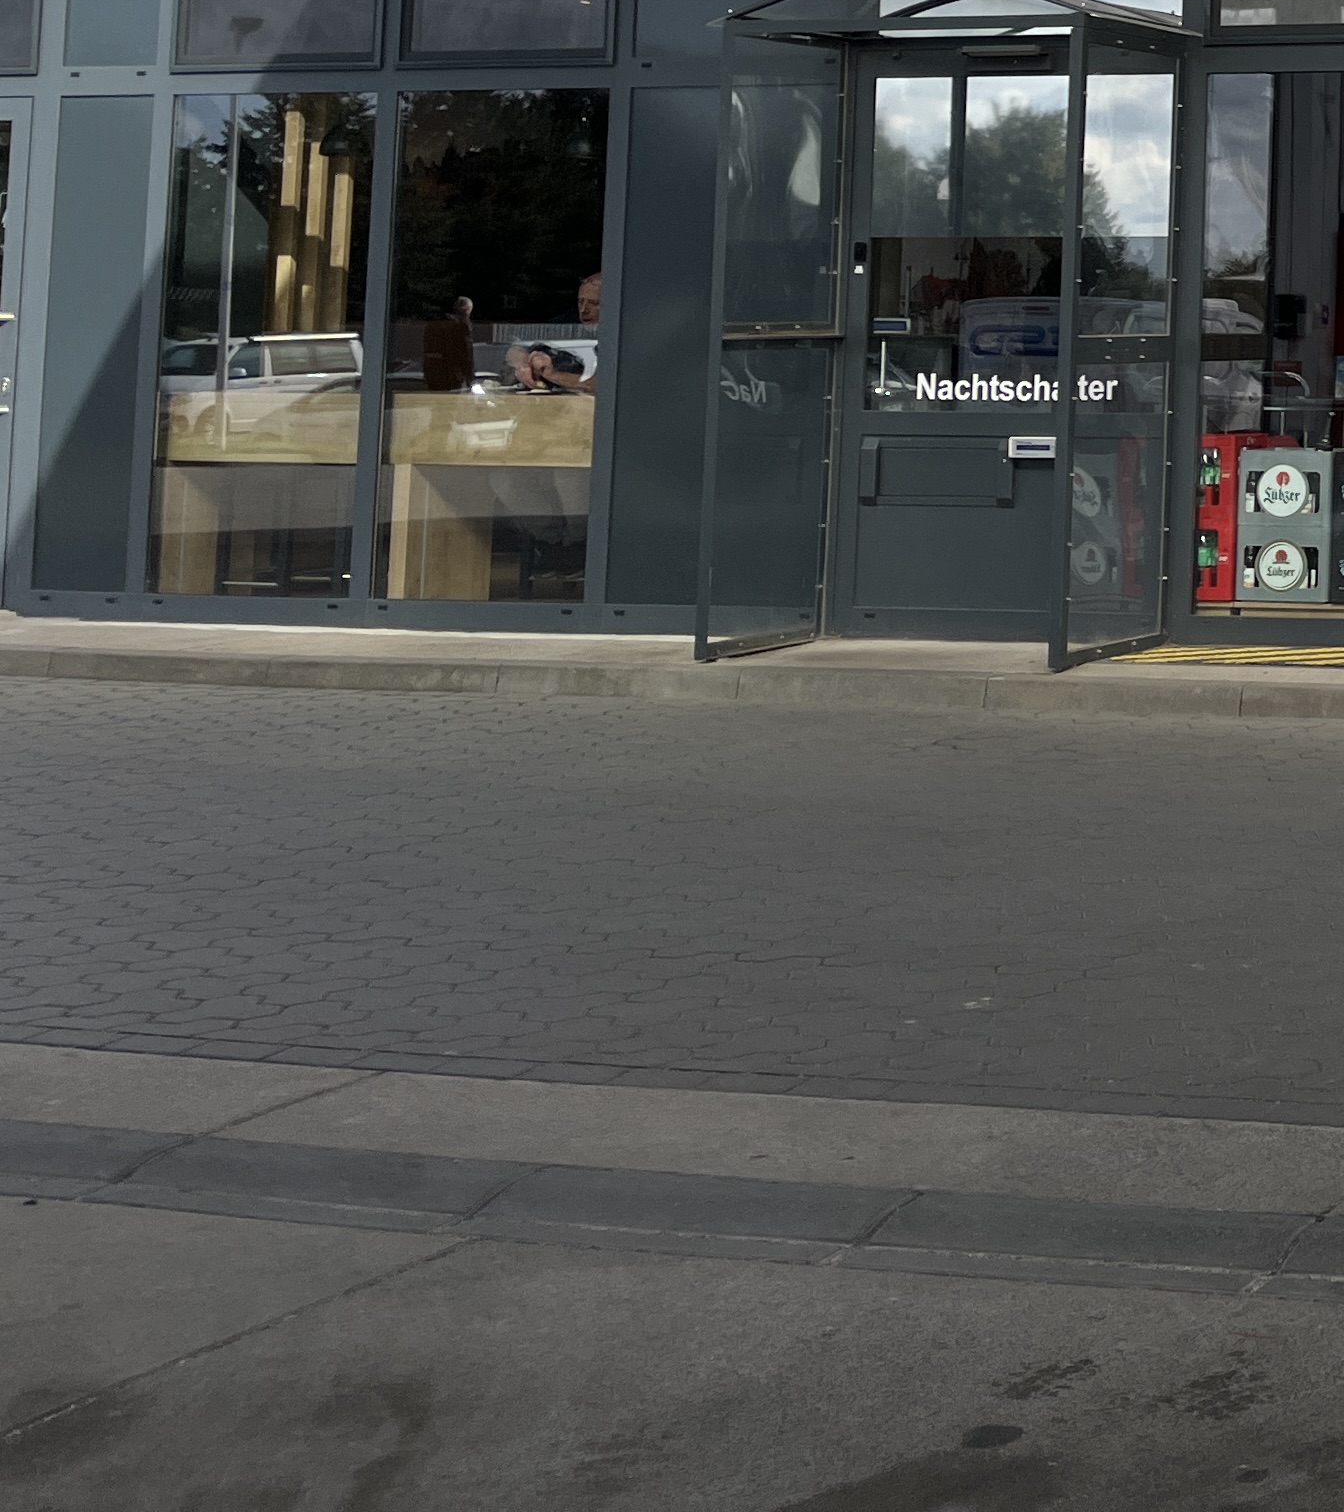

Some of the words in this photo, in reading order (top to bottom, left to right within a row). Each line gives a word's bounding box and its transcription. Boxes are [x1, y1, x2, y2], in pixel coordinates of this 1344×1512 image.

[916, 372, 1118, 402] Nachtschater
[1263, 486, 1301, 505] Lübzer
[1266, 564, 1296, 578] Lübzer
